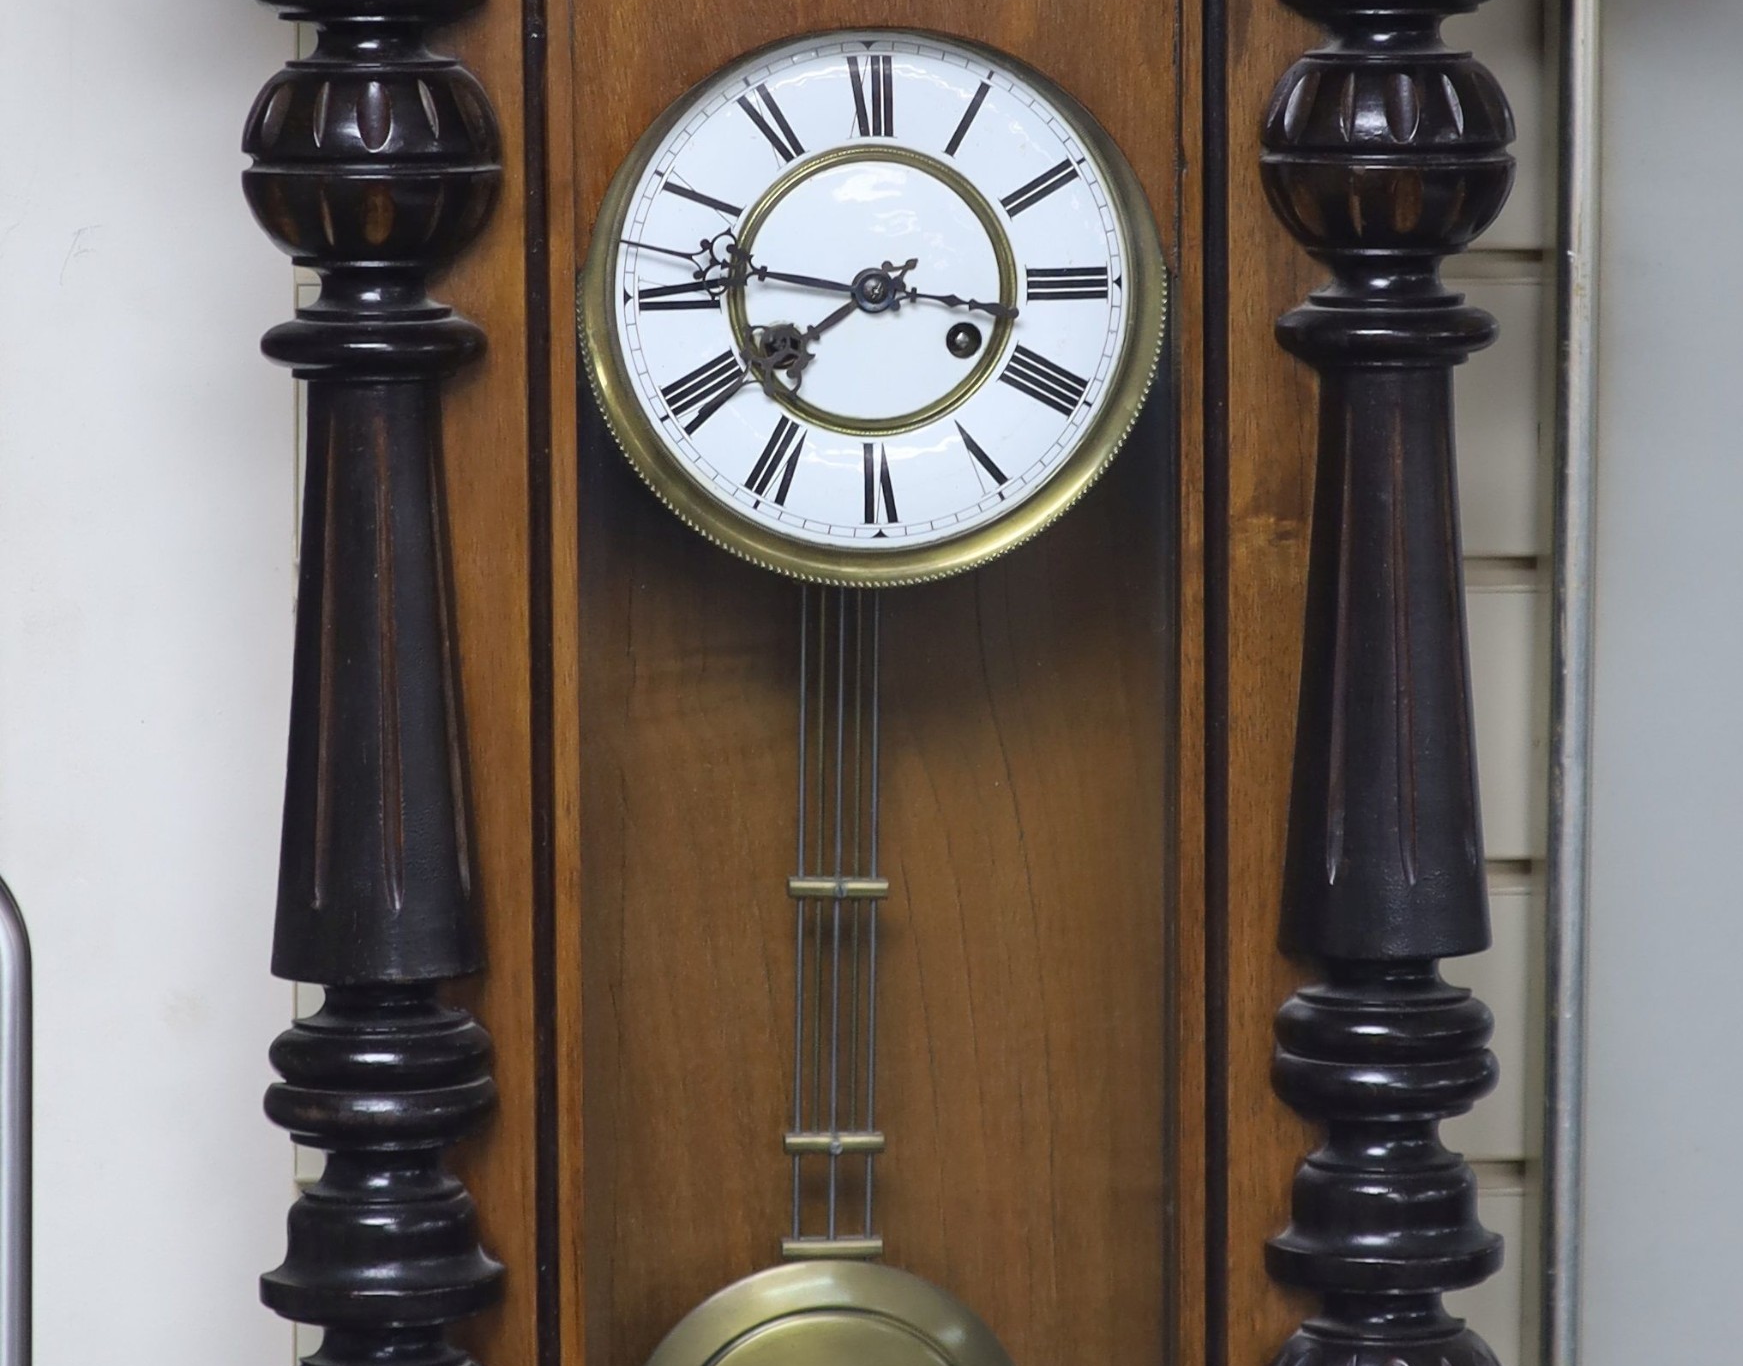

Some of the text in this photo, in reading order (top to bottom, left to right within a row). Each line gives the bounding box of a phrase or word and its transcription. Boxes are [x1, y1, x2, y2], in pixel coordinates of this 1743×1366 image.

[737, 83, 810, 162] XI
[846, 55, 896, 138] XII
[943, 80, 994, 158] I
[658, 167, 744, 224] X
[999, 157, 1081, 219] II
[1026, 267, 1108, 300] III
[998, 343, 1091, 416] IIII
[744, 416, 806, 508] VII
[861, 442, 899, 525] VI
[954, 419, 1010, 498] V
